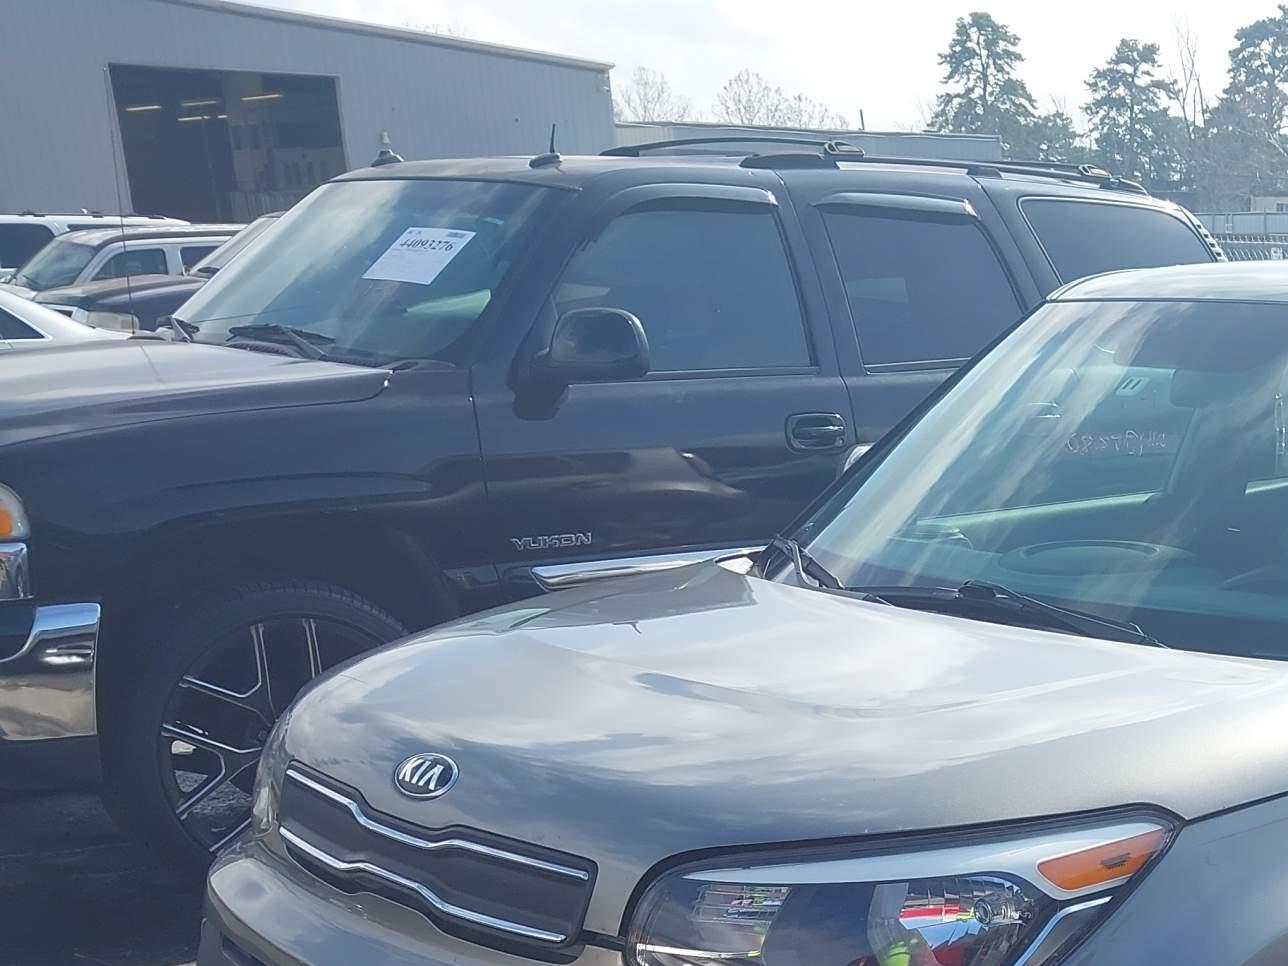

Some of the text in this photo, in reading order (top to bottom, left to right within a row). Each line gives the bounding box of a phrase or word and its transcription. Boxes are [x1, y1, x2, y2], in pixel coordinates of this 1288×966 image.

[399, 238, 454, 252] 44093276
[510, 532, 592, 551] YUKON
[398, 757, 445, 791] KIA
